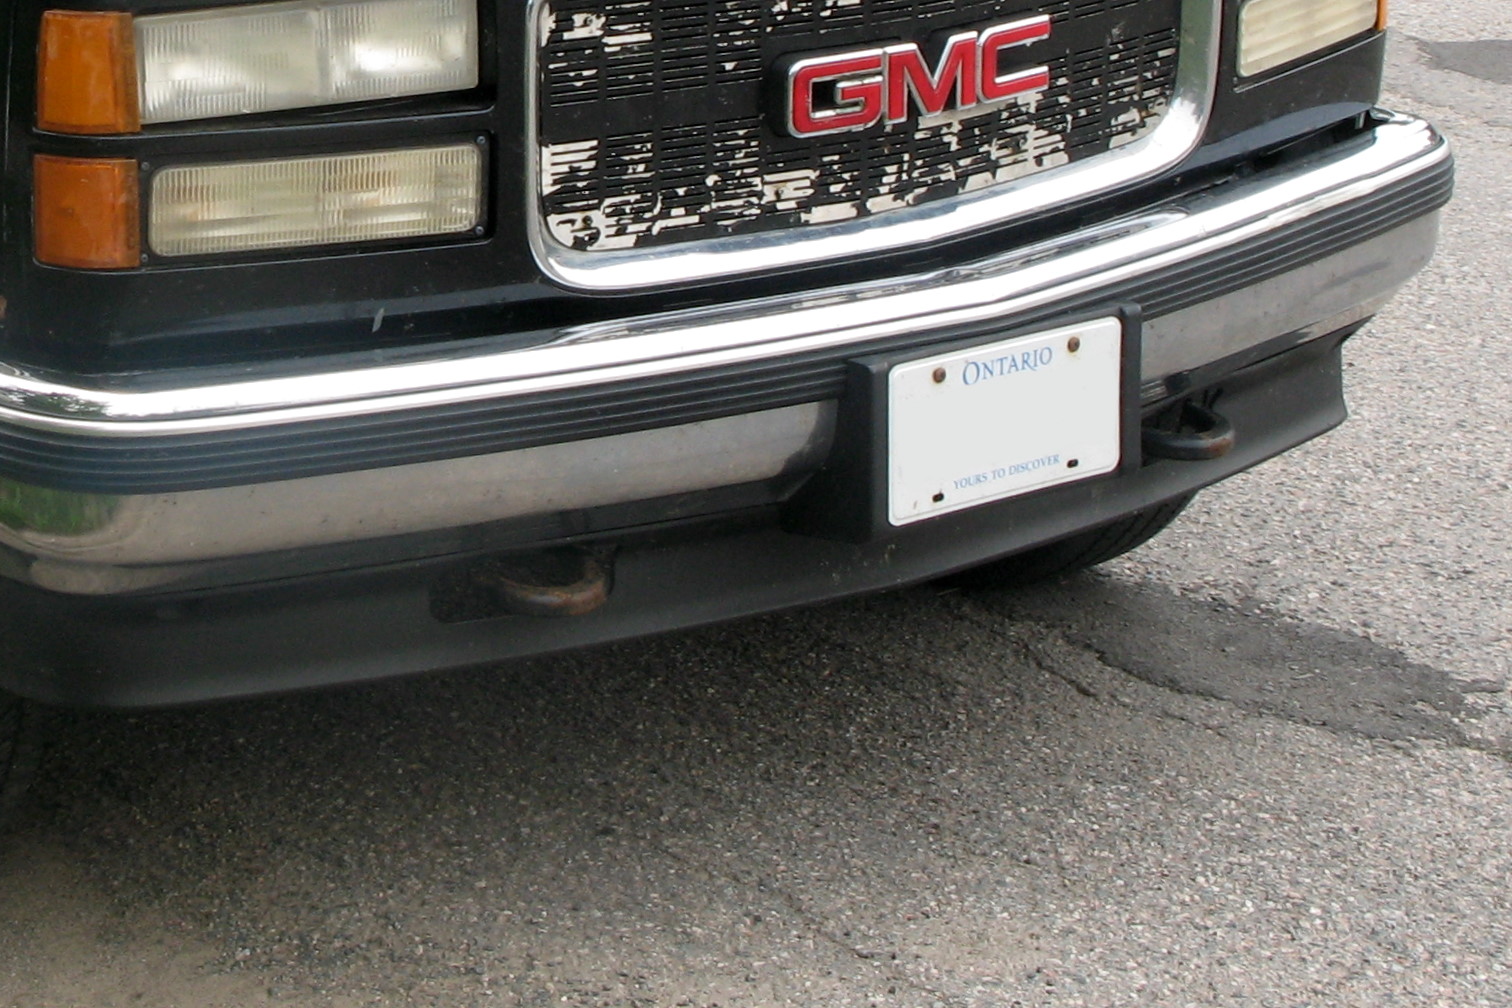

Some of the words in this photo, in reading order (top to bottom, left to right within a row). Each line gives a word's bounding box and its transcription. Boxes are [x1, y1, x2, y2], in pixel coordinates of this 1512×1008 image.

[788, 13, 1051, 139] GMC
[961, 346, 1054, 386] ONTARIO
[953, 472, 988, 490] YOURS
[991, 467, 1006, 481] TO
[1008, 454, 1061, 476] DISCOVER
